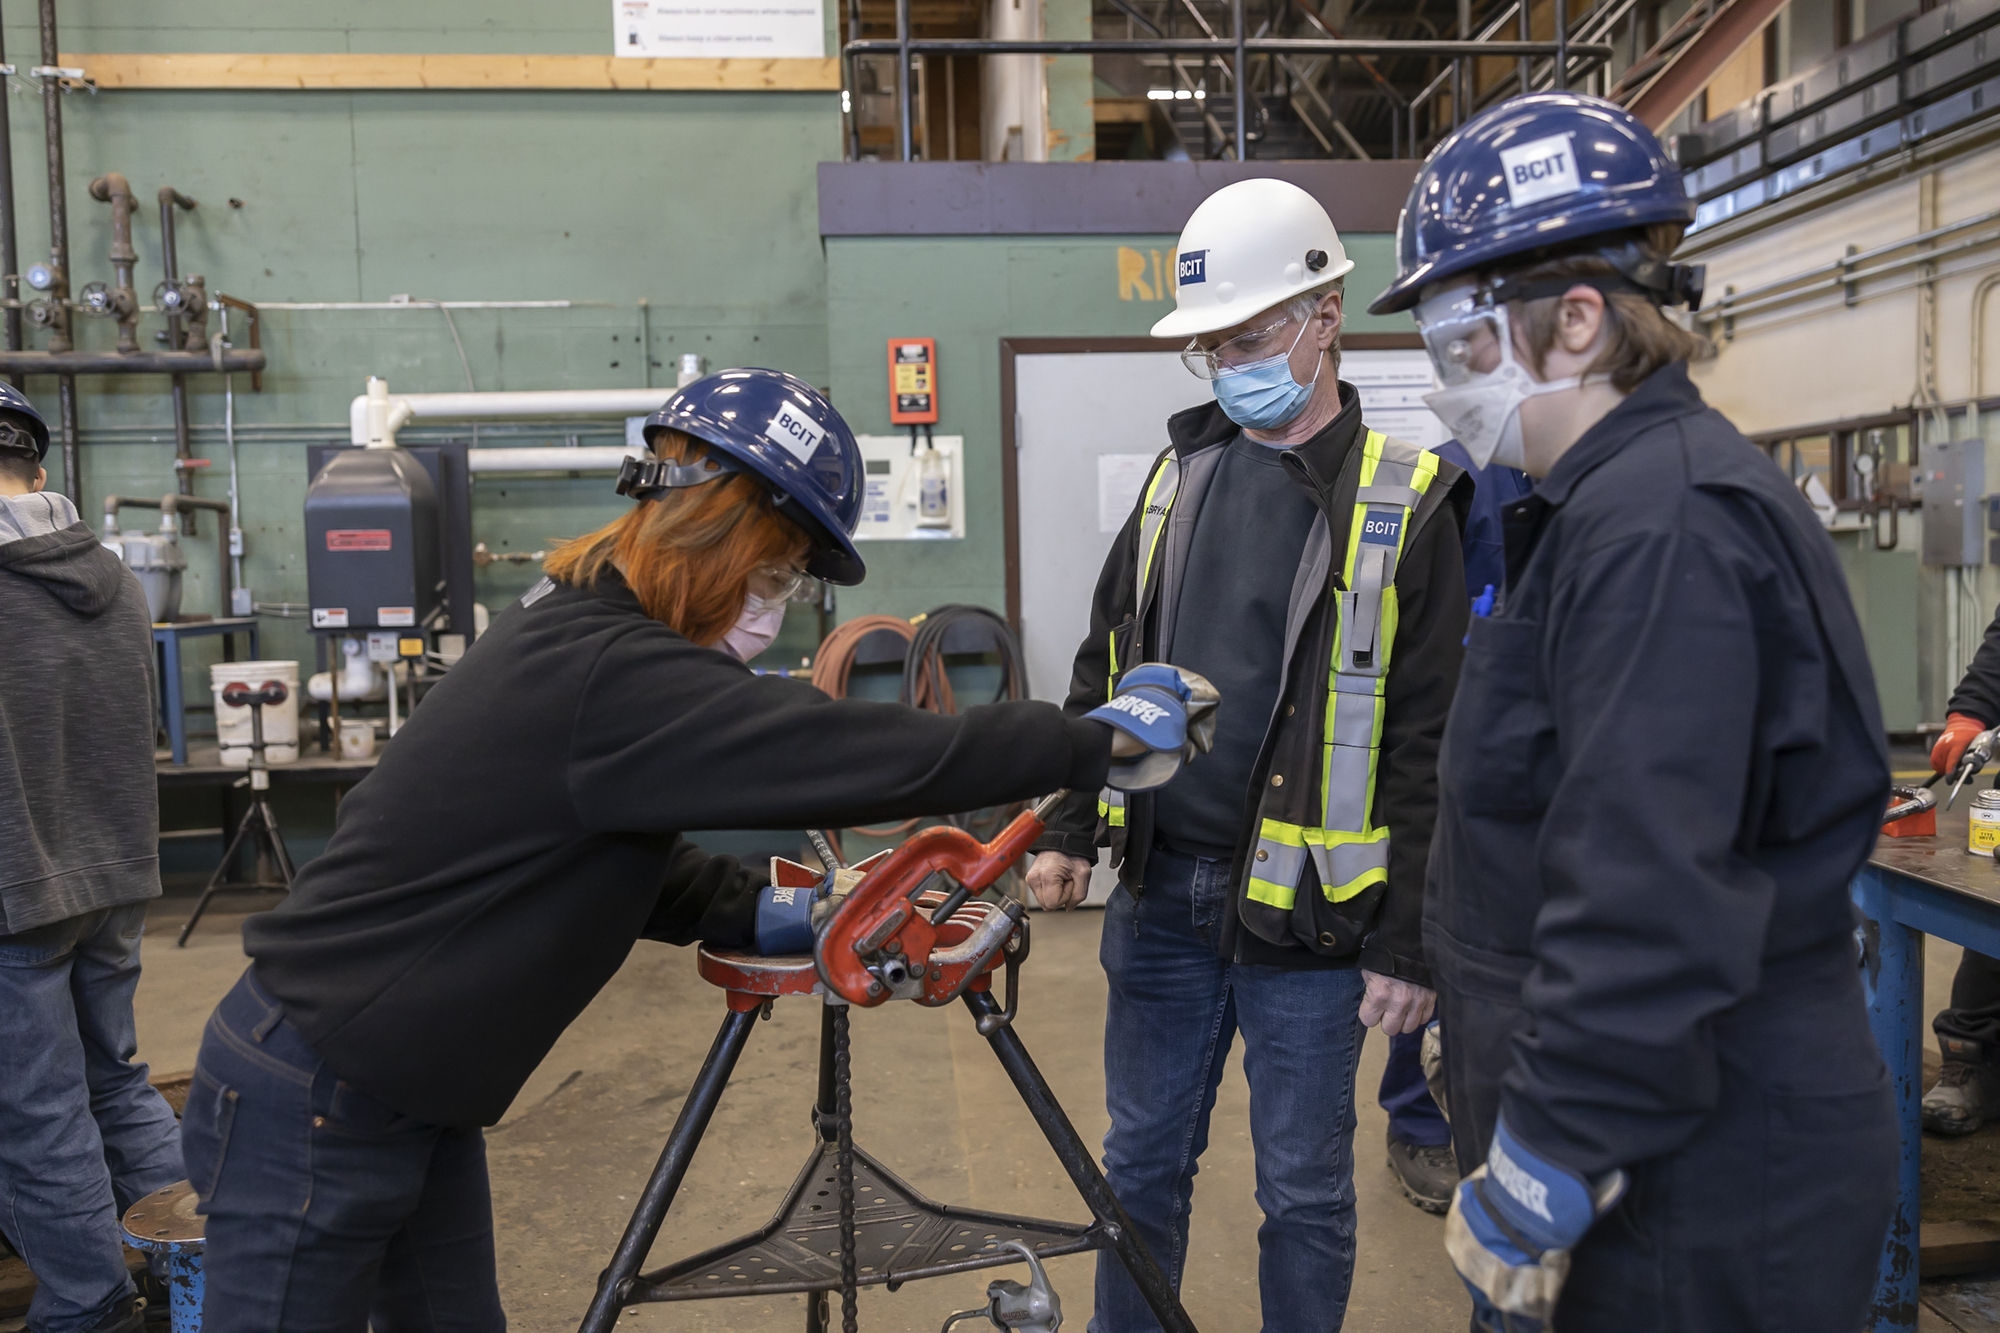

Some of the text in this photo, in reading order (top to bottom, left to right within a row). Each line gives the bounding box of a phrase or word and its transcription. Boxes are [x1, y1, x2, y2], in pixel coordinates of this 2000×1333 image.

[1513, 153, 1565, 185] BCIT
[1180, 259, 1202, 278] BCIT
[779, 413, 817, 447] BCIT
[1365, 521, 1399, 536] BCIT
